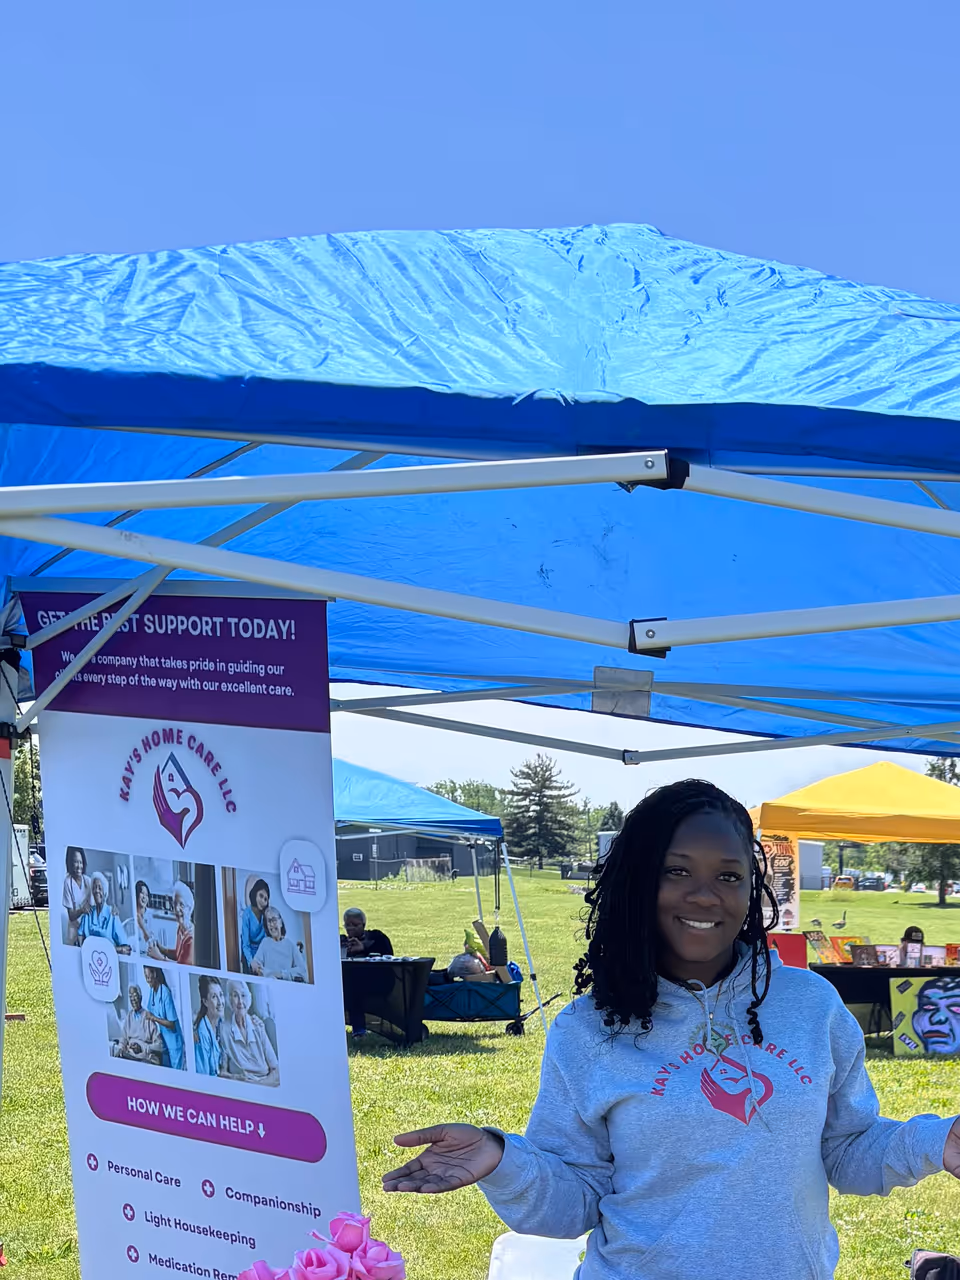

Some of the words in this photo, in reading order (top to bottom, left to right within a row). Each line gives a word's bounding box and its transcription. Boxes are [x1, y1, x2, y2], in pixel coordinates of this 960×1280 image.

[143, 614, 224, 637] SUPPORT
[227, 617, 296, 640] TODAY!
[97, 655, 138, 668] company
[139, 655, 160, 667] that
[161, 656, 188, 669] takes
[189, 658, 215, 672] pride
[216, 659, 226, 672] in
[228, 660, 265, 676] guiding
[266, 665, 285, 675] our
[83, 673, 106, 686] every
[107, 674, 127, 687] step
[129, 674, 139, 686] of
[141, 674, 157, 687] the
[158, 678, 178, 691] way
[179, 676, 201, 690] with
[202, 680, 219, 692] our
[221, 680, 267, 695] excellent
[268, 685, 295, 696] care.
[119, 747, 143, 803] KAY'S
[141, 727, 183, 754] HOME
[187, 734, 222, 777] CARE
[218, 778, 237, 813] LLC
[900, 1034, 917, 1050] EVIL
[679, 1033, 734, 1065] HOE
[787, 1058, 813, 1085] LLC
[127, 1095, 160, 1116] HOW
[161, 1102, 185, 1122] WE
[187, 1108, 217, 1129] CAN
[220, 1115, 254, 1135] HELP
[107, 1160, 153, 1181] Personal
[154, 1171, 181, 1188] Care
[225, 1186, 322, 1219] Companionship
[144, 1210, 172, 1229] Light
[173, 1217, 256, 1250] Housekeeping
[148, 1252, 211, 1278] Medication
